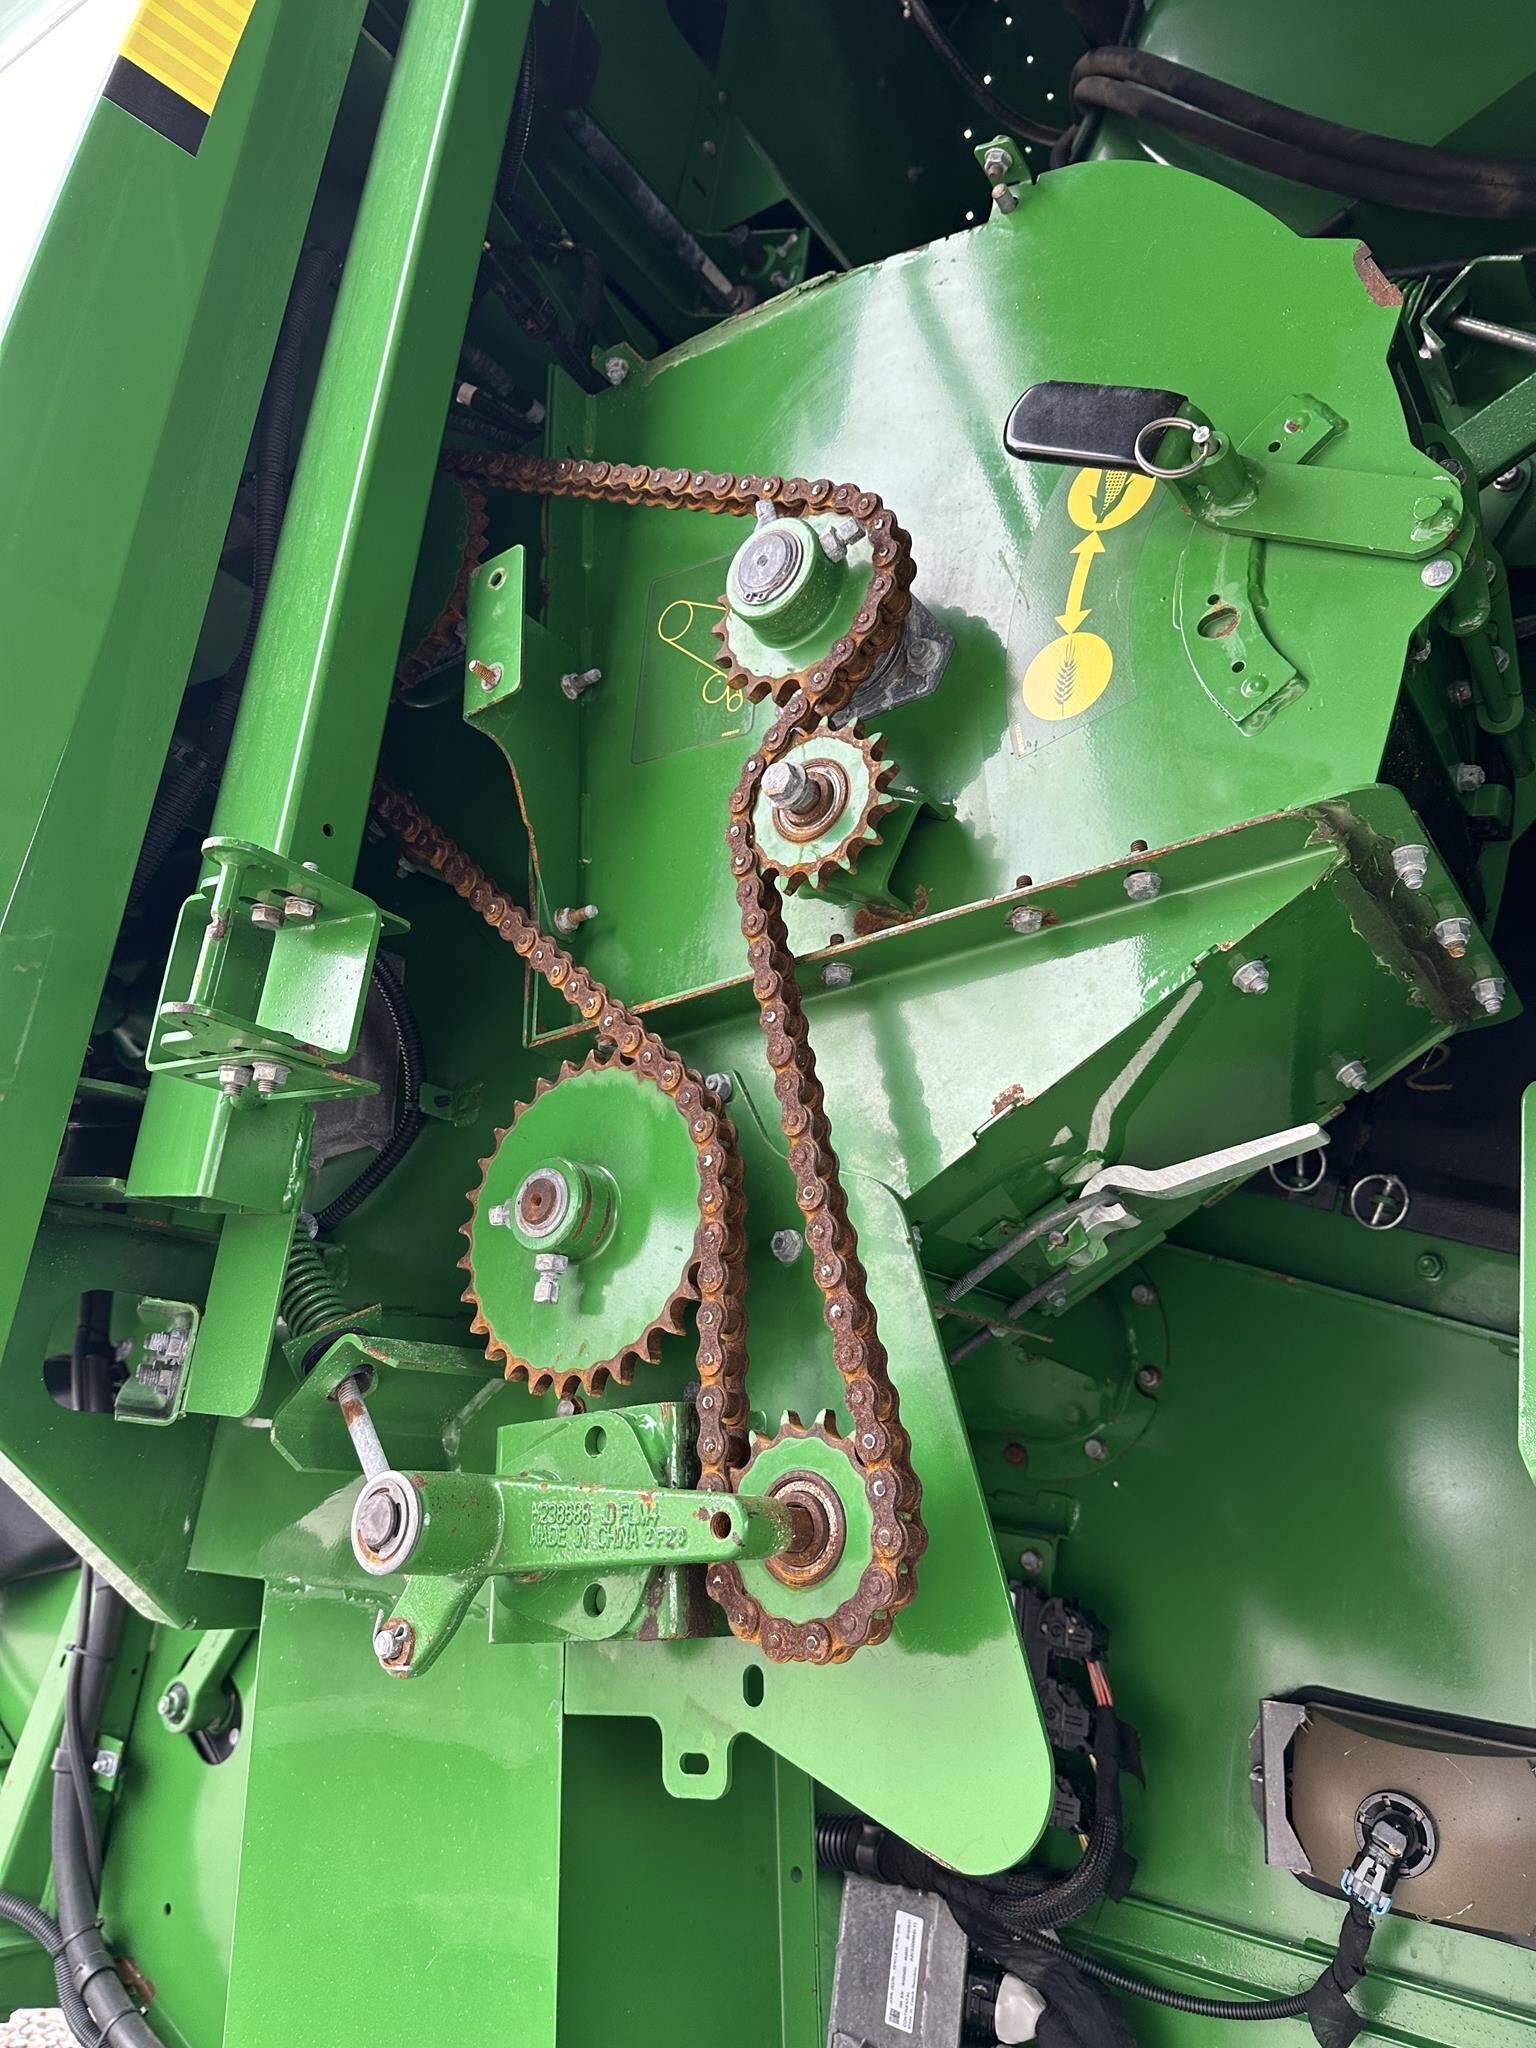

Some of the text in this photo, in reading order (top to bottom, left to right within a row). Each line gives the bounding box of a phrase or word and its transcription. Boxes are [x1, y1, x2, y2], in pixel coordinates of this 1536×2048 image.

[530, 1523, 567, 1548] MADE
[572, 1524, 588, 1549] IN
[597, 1525, 640, 1550] CHINA
